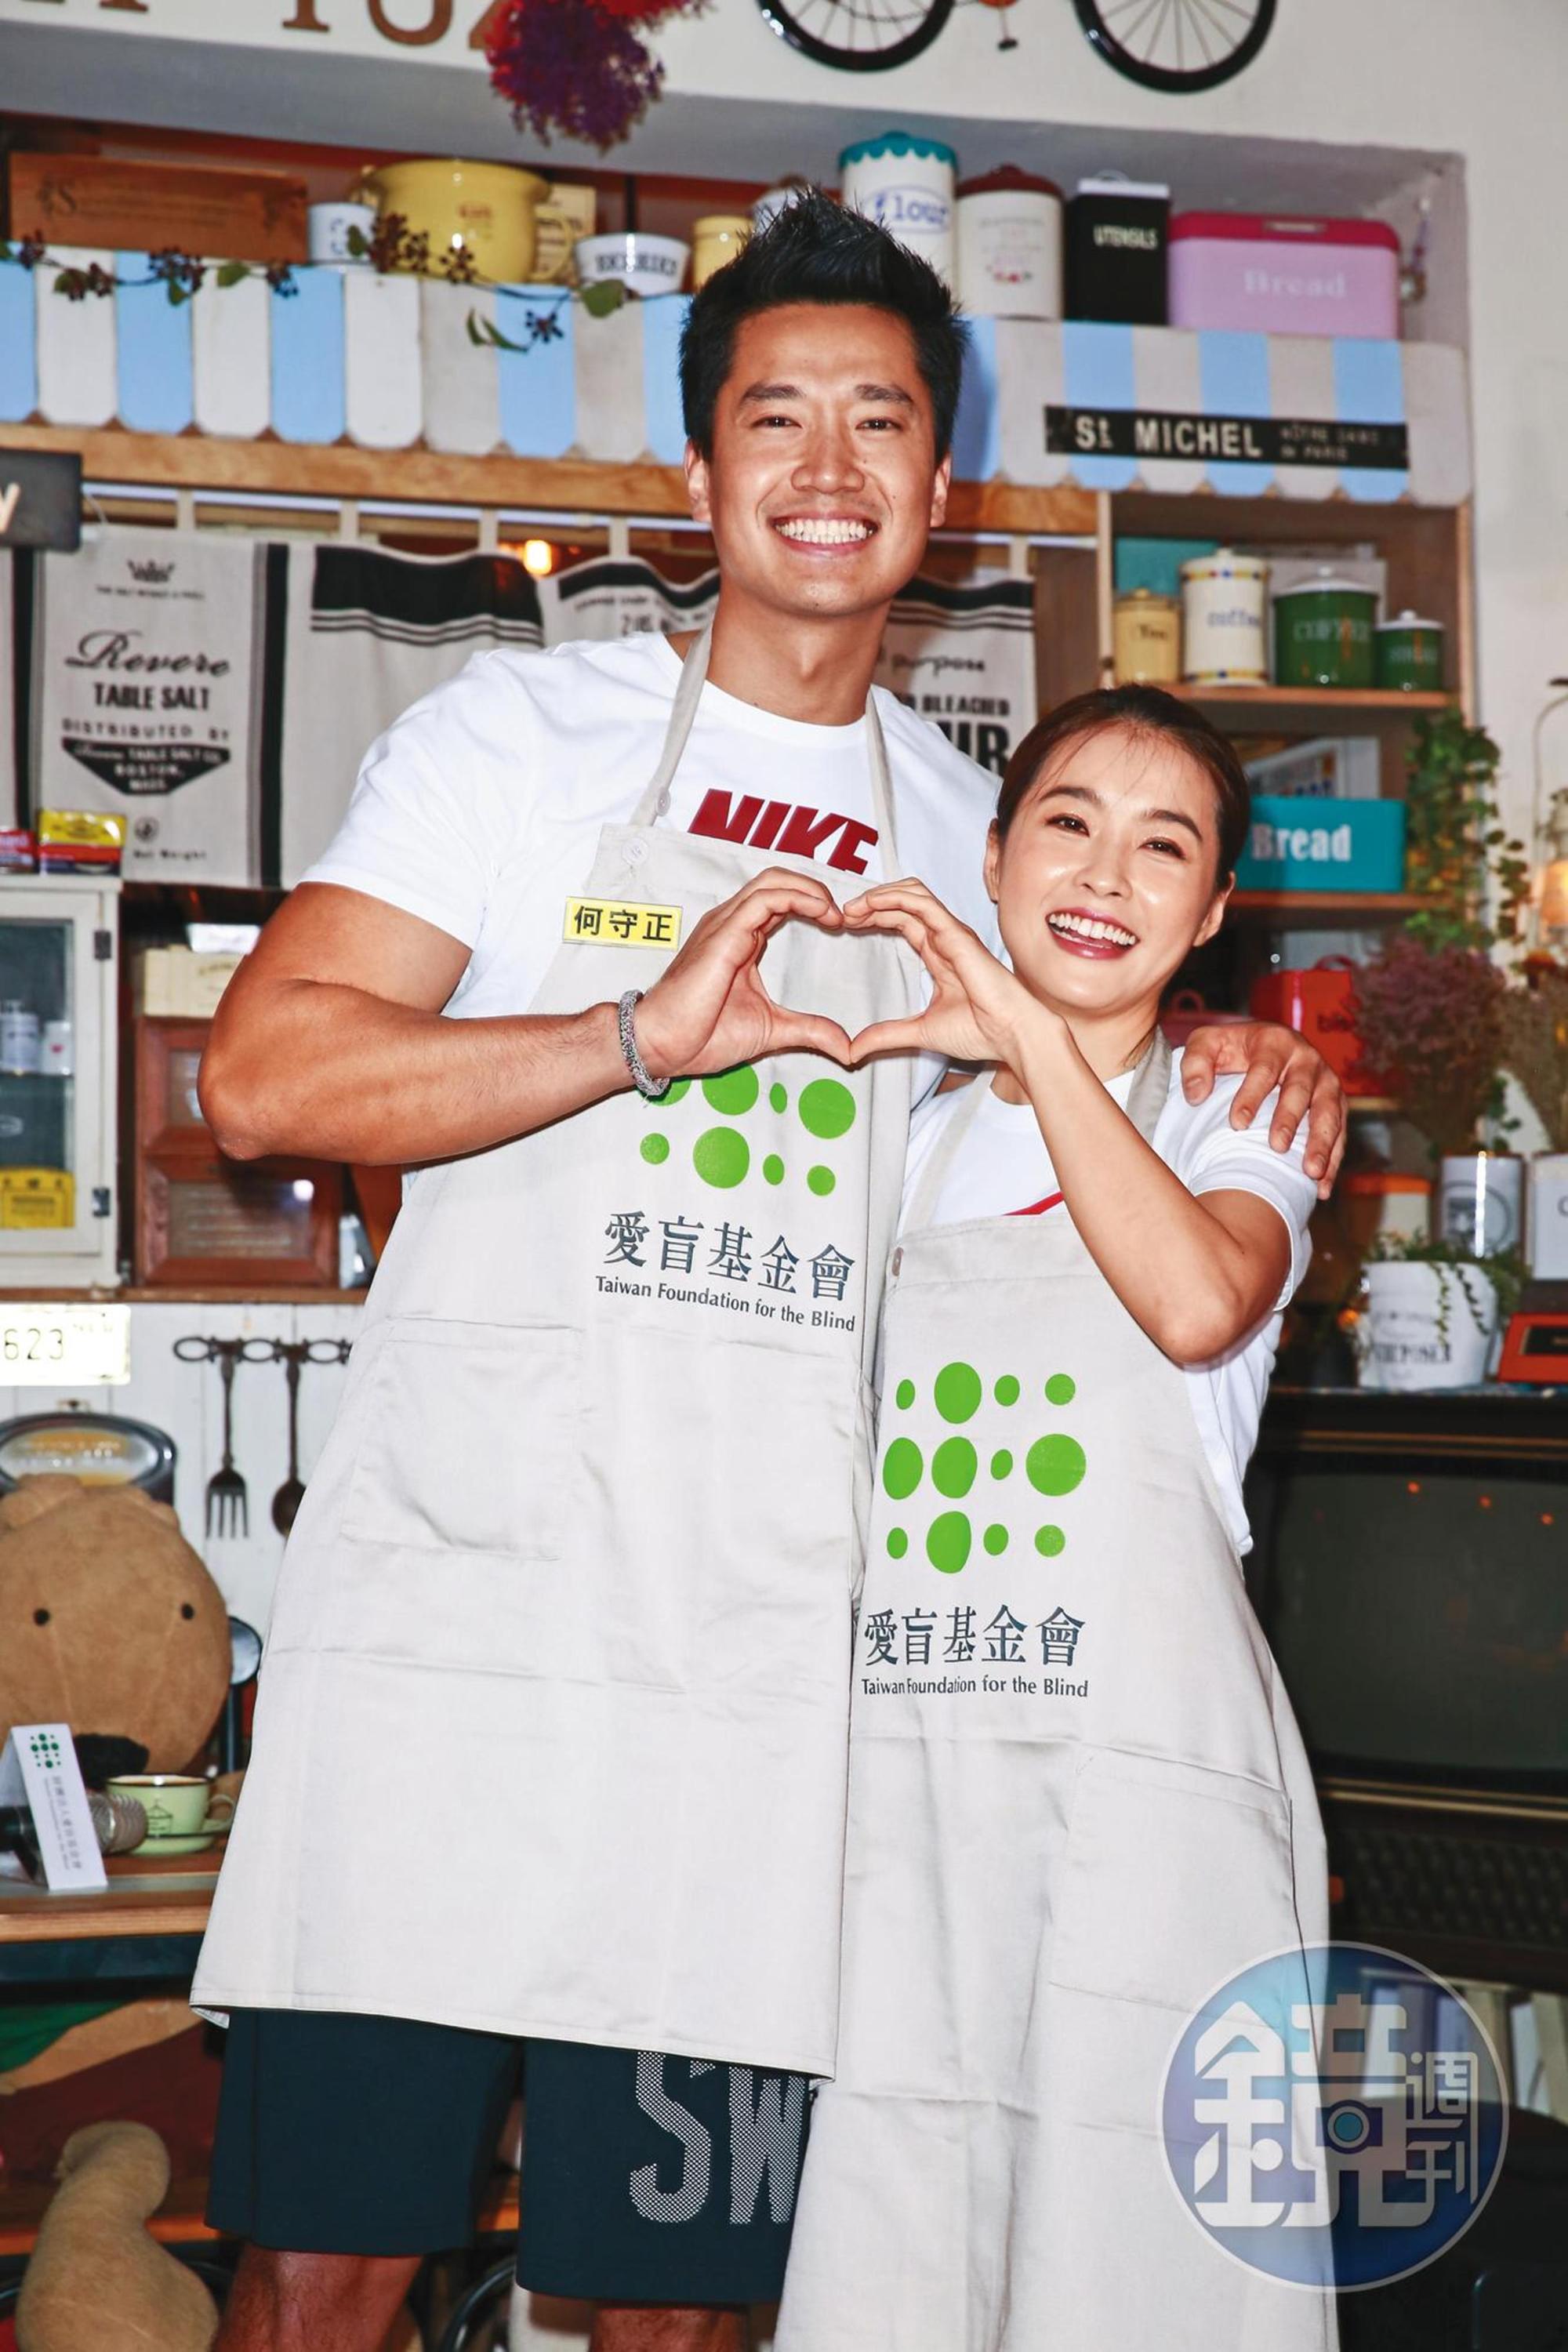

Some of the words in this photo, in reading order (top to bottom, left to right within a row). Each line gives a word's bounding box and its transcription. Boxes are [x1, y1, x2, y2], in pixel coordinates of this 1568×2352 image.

[875, 193, 948, 224] flour
[1094, 224, 1158, 250] UTENSILS
[1243, 270, 1346, 298] Bread
[1134, 419, 1262, 457] MICHEL
[64, 629, 230, 678] Revere
[94, 682, 153, 710] TABLE
[161, 685, 209, 710] SALT
[922, 695, 1010, 717] BLEACHED
[62, 718, 193, 738] DISTRIBUTED
[209, 728, 229, 740] BY
[687, 788, 879, 875] NIKE
[1251, 823, 1352, 862] Bread
[574, 906, 672, 942] 何守正
[603, 1210, 855, 1301] 愛盲基金會
[596, 1276, 652, 1298] Taiwan
[658, 1283, 750, 1312] Foundation
[755, 1299, 775, 1318] for
[781, 1305, 804, 1324] the
[811, 1311, 855, 1332] Blind
[864, 1604, 1086, 1667] 愛盲基金會
[862, 1677, 906, 1695] Taiwan
[907, 1676, 976, 1694] Foundation
[982, 1675, 1007, 1693] for
[1012, 1676, 1036, 1694] the
[1044, 1678, 1088, 1697] Blind
